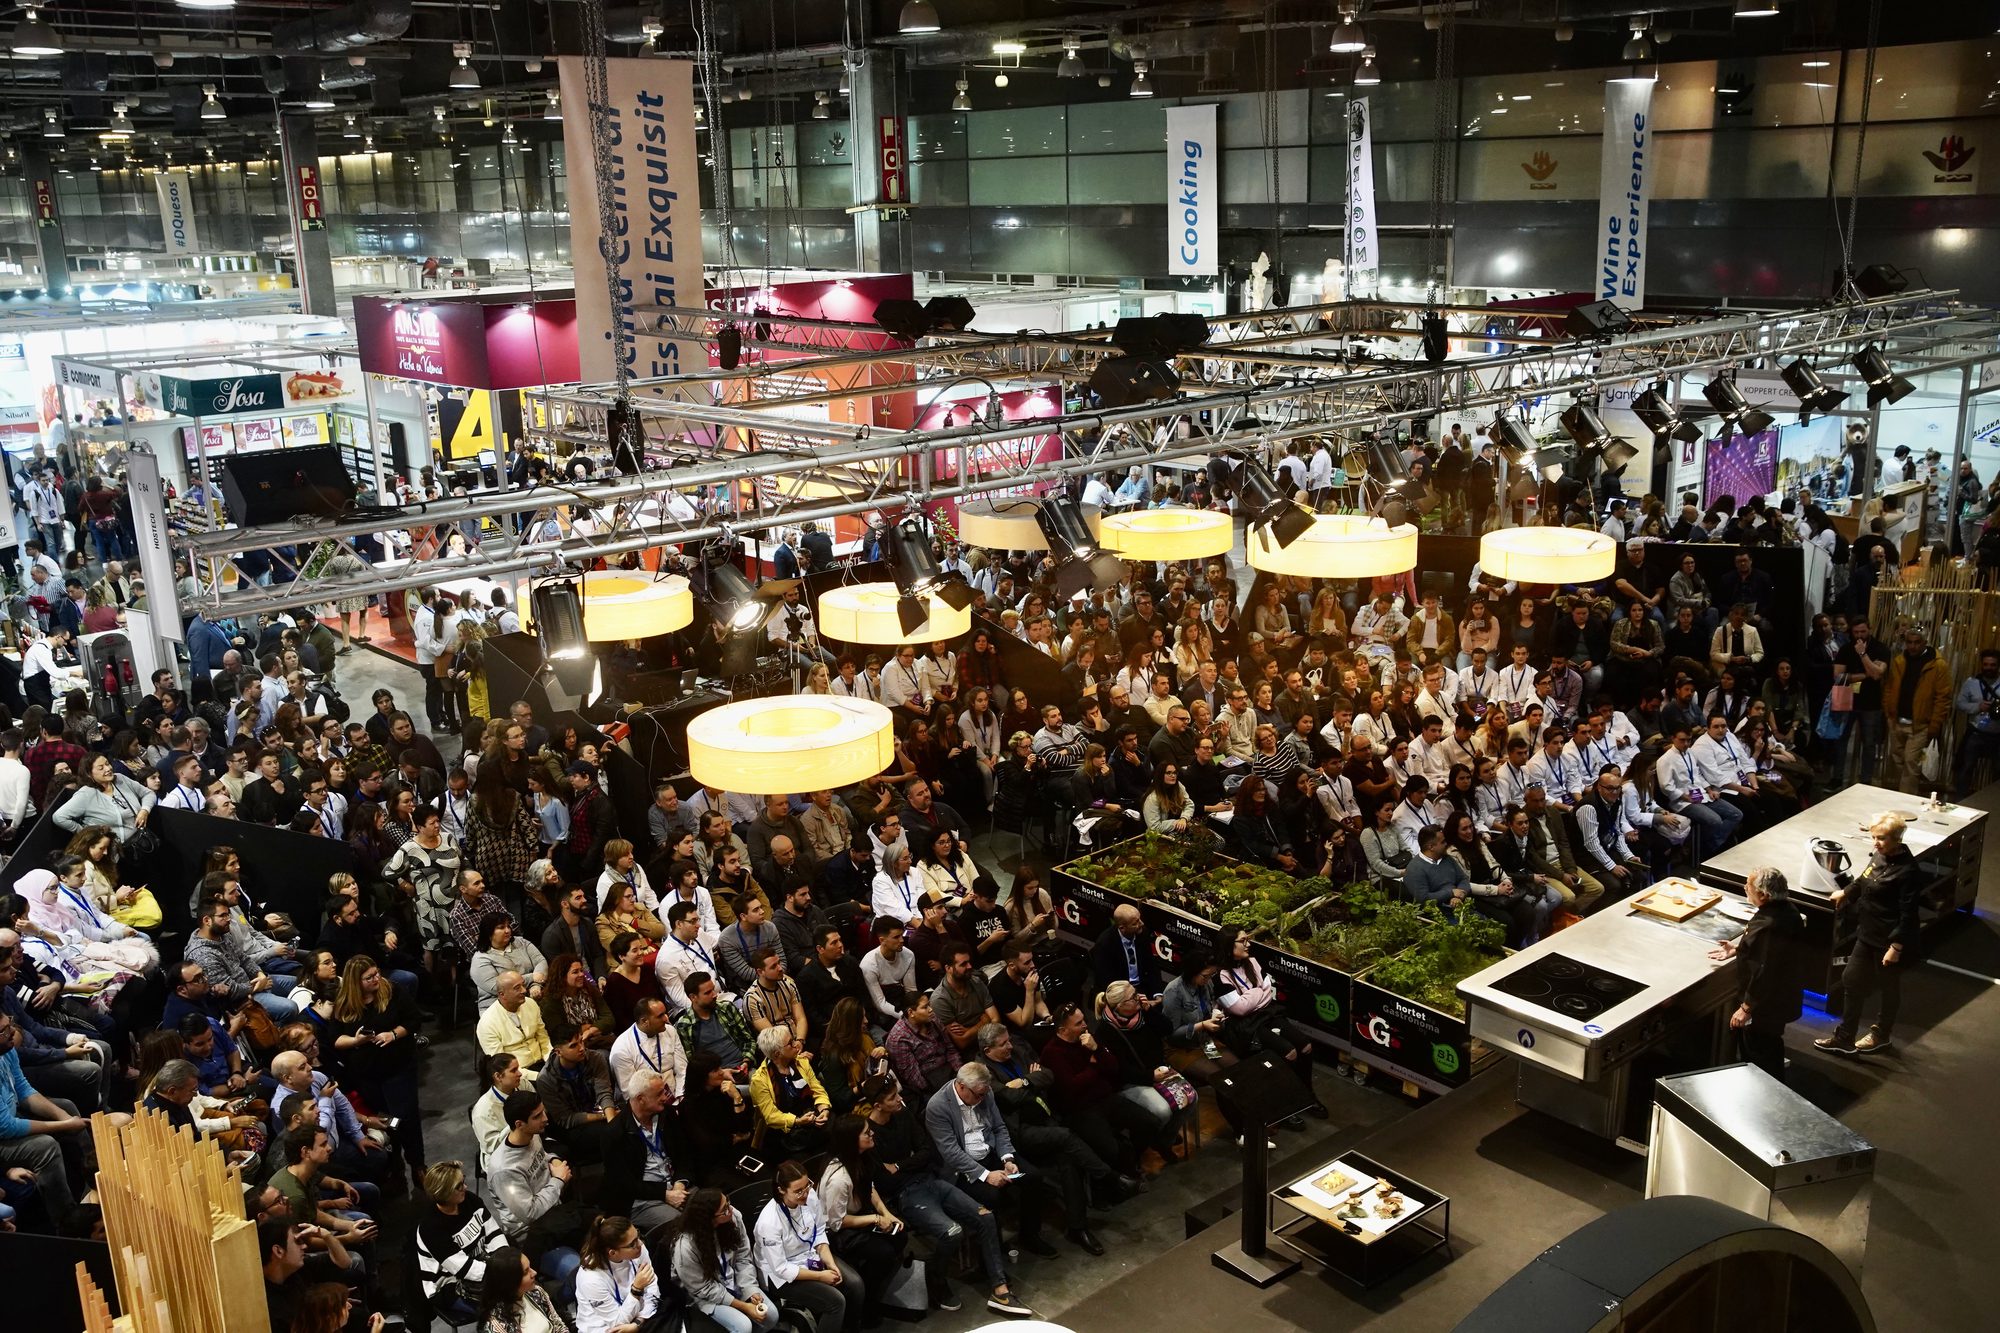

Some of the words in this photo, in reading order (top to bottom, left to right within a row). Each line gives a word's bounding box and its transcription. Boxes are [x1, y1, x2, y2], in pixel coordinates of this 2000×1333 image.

[634, 90, 678, 263] Exquisit
[169, 182, 186, 247] #DQuesos
[1179, 140, 1203, 265] Cooking
[1621, 112, 1645, 297] Experience
[1602, 216, 1621, 299] Wine
[168, 380, 188, 412] Sosa
[213, 379, 266, 412] Sosa
[1744, 386, 1776, 396] KOPPERT
[246, 422, 270, 442] Sosa
[138, 482, 142, 491] C
[142, 483, 149, 493] 64
[150, 513, 160, 550] HOSTECO
[1081, 885, 1104, 900] hortet
[1063, 899, 1080, 926] G
[1176, 920, 1201, 936] hortet
[1155, 934, 1173, 962] G
[1280, 957, 1309, 974] hortet
[1320, 999, 1336, 1012] sh
[1396, 1002, 1426, 1021] hortet
[1368, 1016, 1390, 1048] G
[1437, 1049, 1455, 1064] sh
